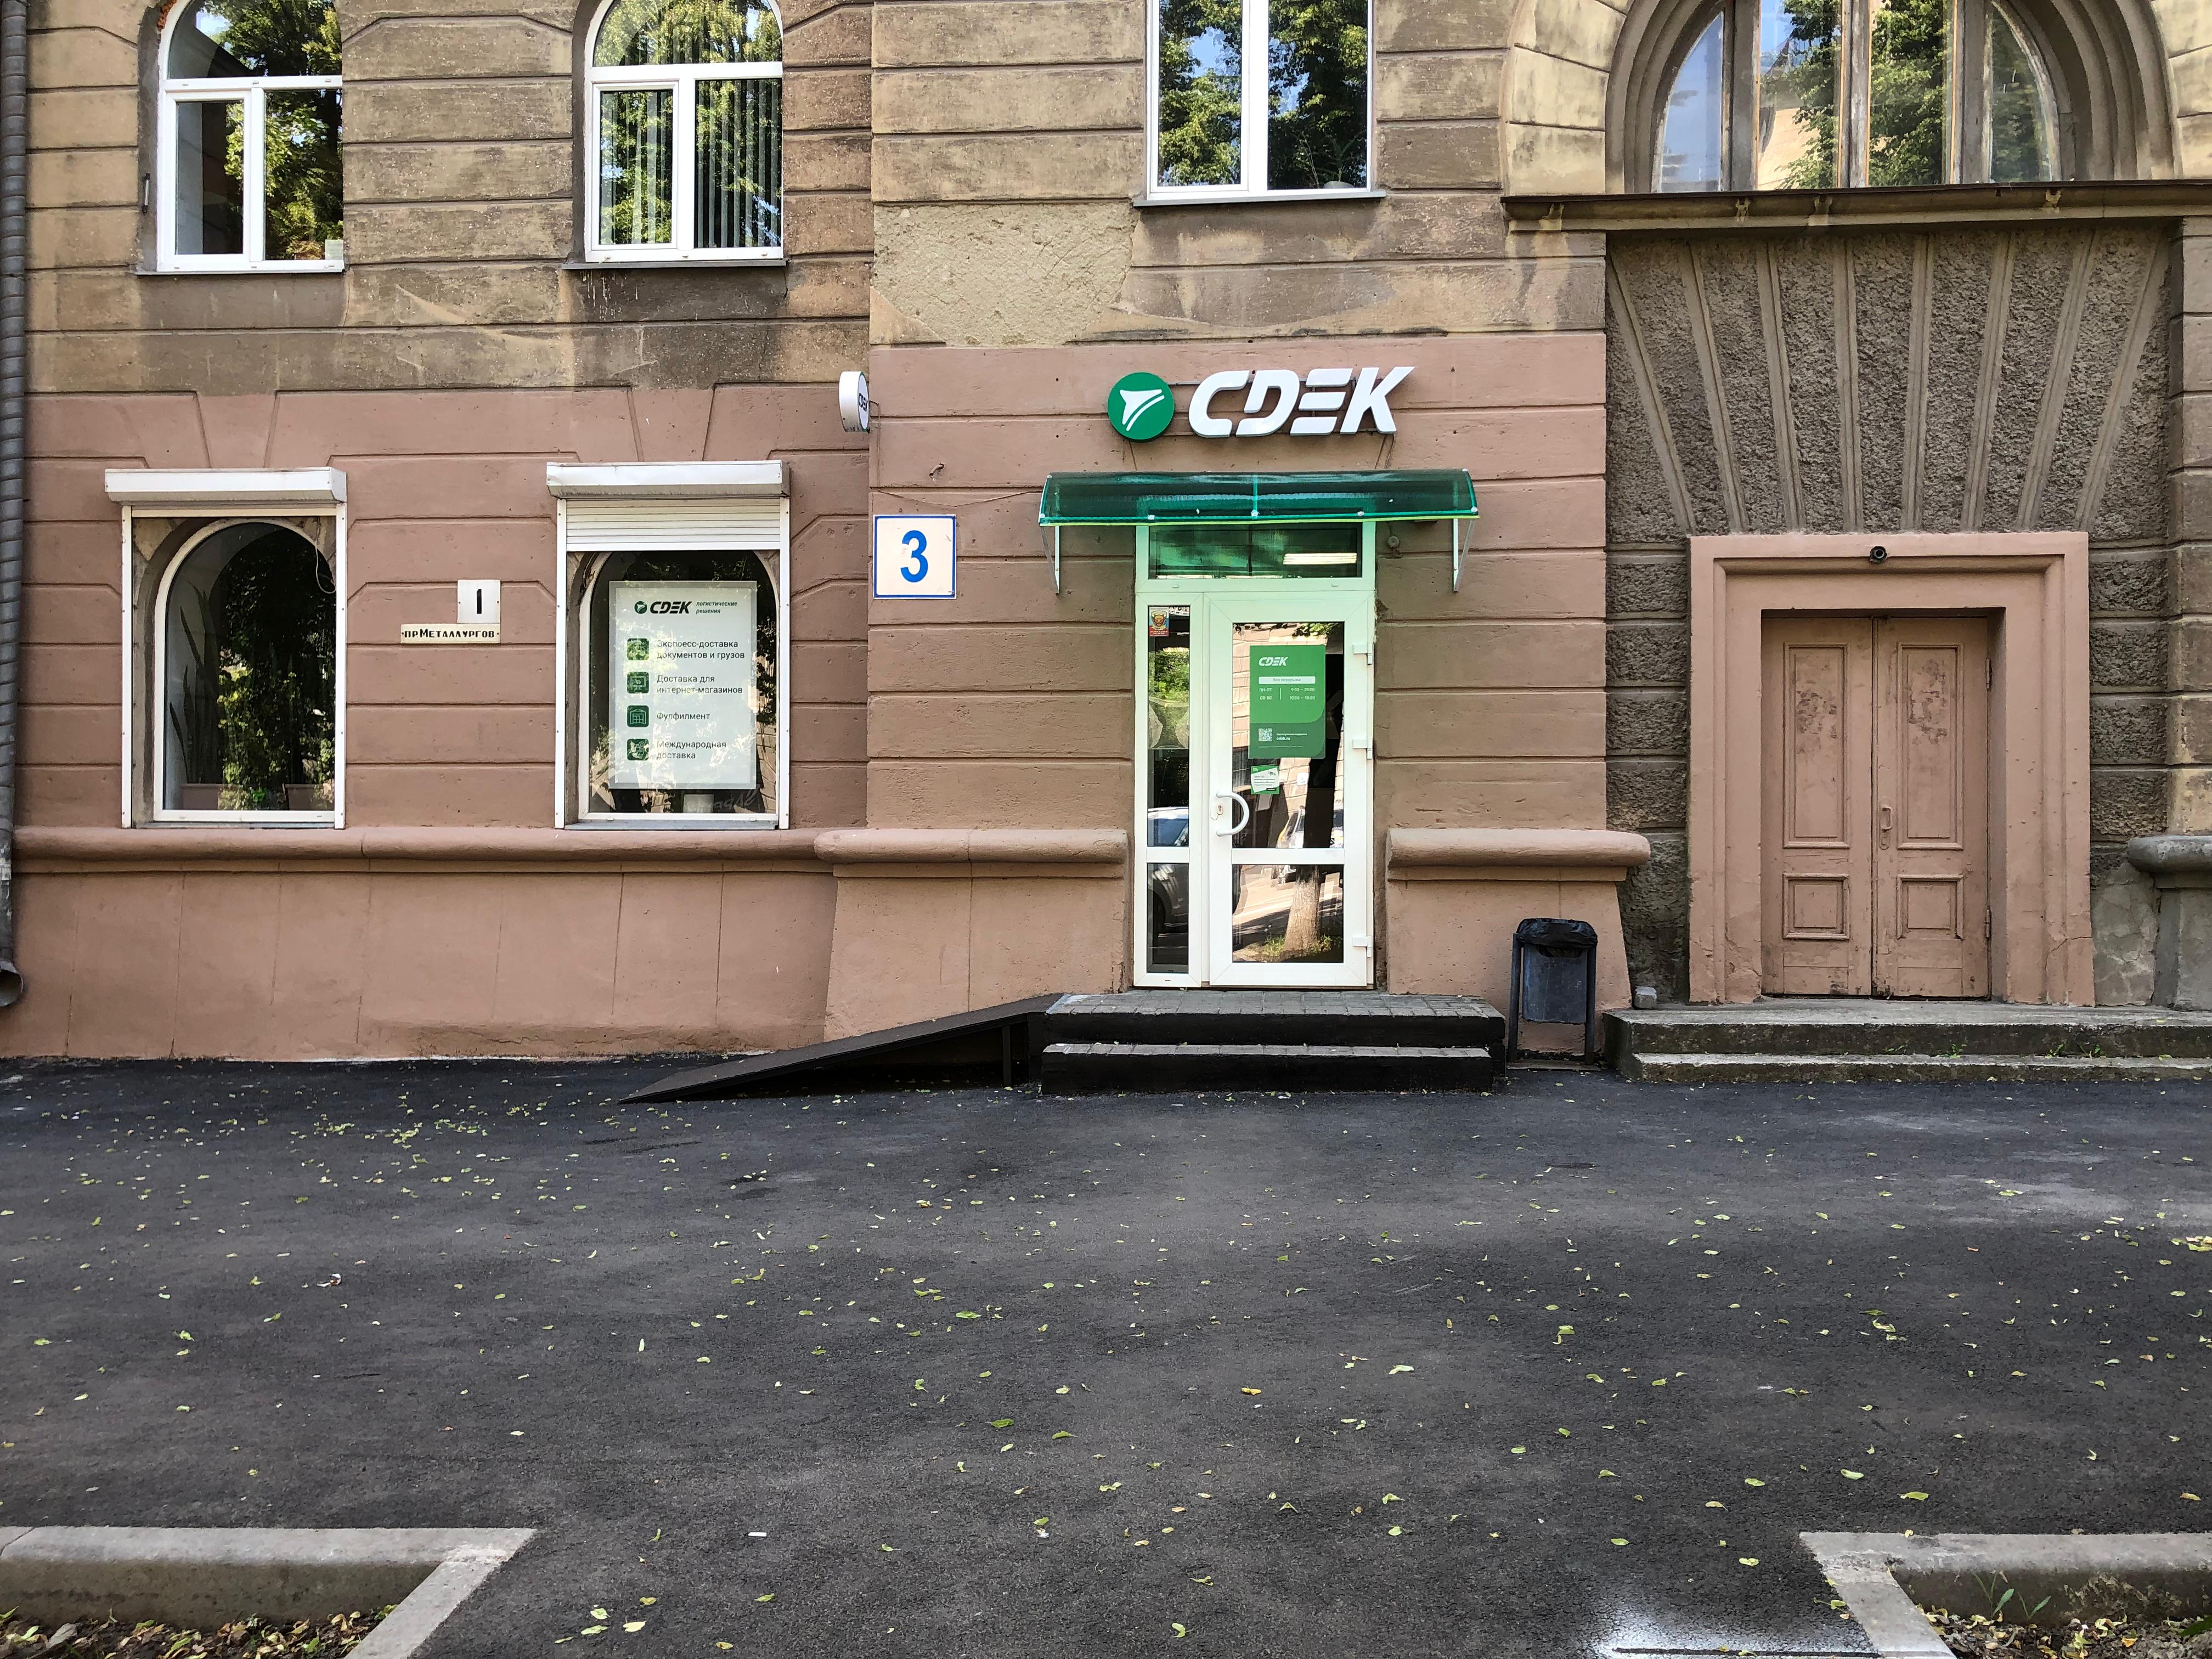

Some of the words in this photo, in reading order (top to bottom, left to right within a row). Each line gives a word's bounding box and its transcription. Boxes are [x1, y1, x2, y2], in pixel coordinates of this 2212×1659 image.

[1189, 366, 1415, 437] CDEK
[900, 530, 928, 583] 3
[477, 589, 482, 614] 1
[650, 601, 692, 614] CDEK
[1259, 657, 1288, 666] CDEK
[657, 675, 697, 684] Доставка
[657, 713, 710, 721] Фулфилмент
